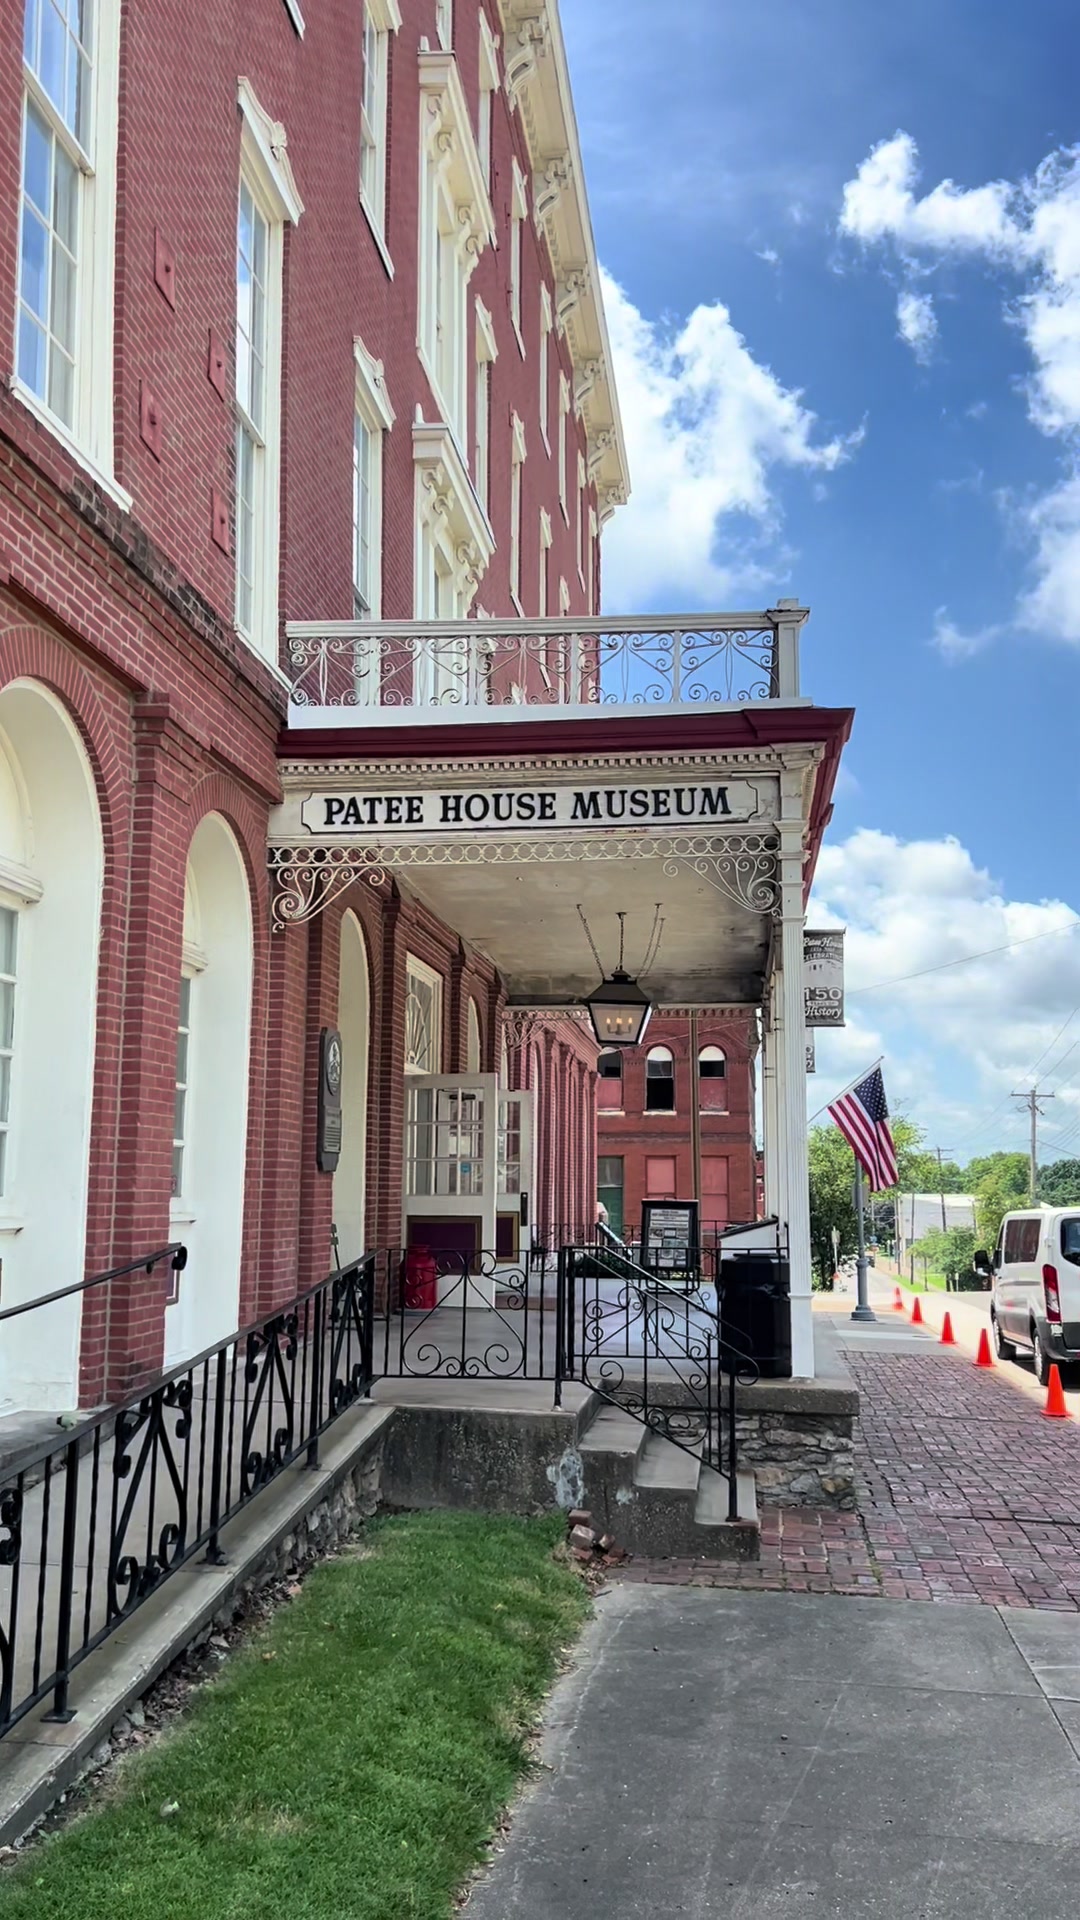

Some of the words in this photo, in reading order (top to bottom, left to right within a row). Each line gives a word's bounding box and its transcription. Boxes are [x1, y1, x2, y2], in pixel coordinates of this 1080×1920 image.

[323, 796, 424, 825] PATEE
[439, 792, 556, 822] HOUSE
[570, 787, 732, 820] MUSEUM
[804, 988, 842, 1000] 150
[804, 1005, 842, 1019] History
